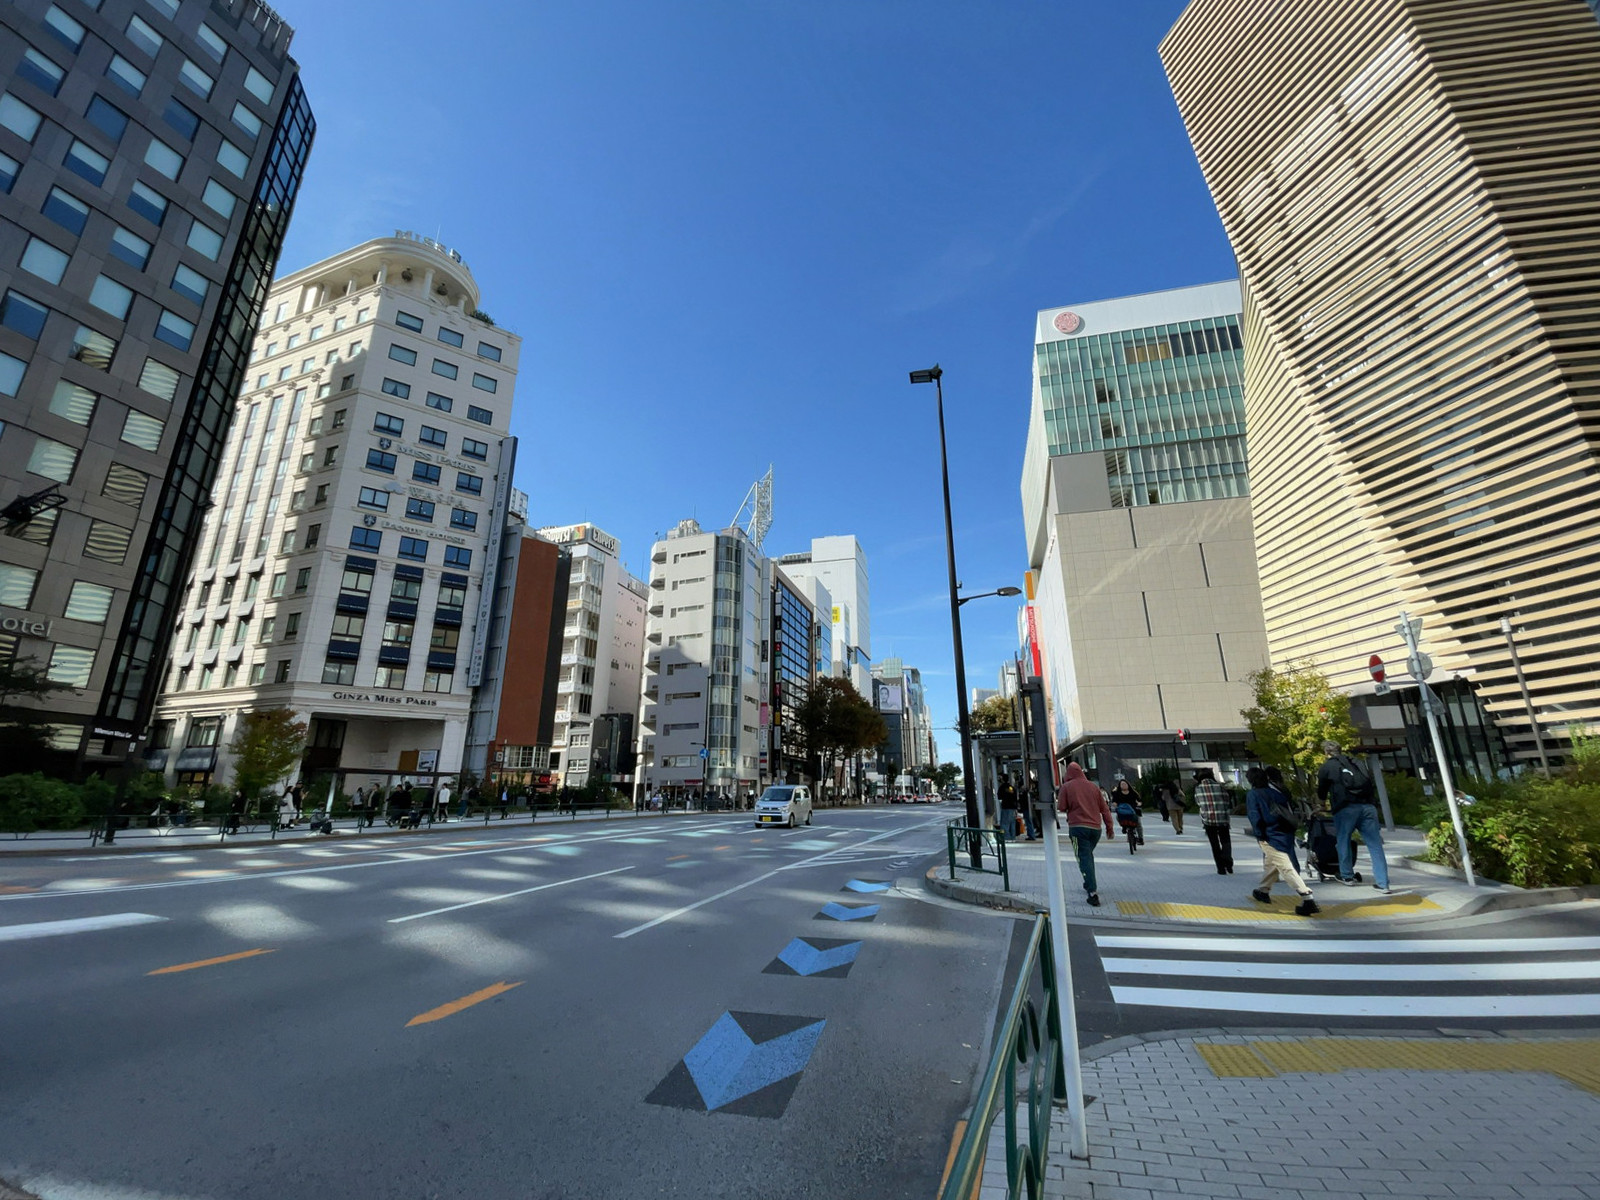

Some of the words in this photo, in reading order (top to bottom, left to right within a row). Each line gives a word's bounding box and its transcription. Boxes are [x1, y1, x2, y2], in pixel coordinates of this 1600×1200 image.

[333, 691, 370, 701] GINZA
[374, 694, 402, 704] MISS
[405, 697, 437, 706] PARIS
